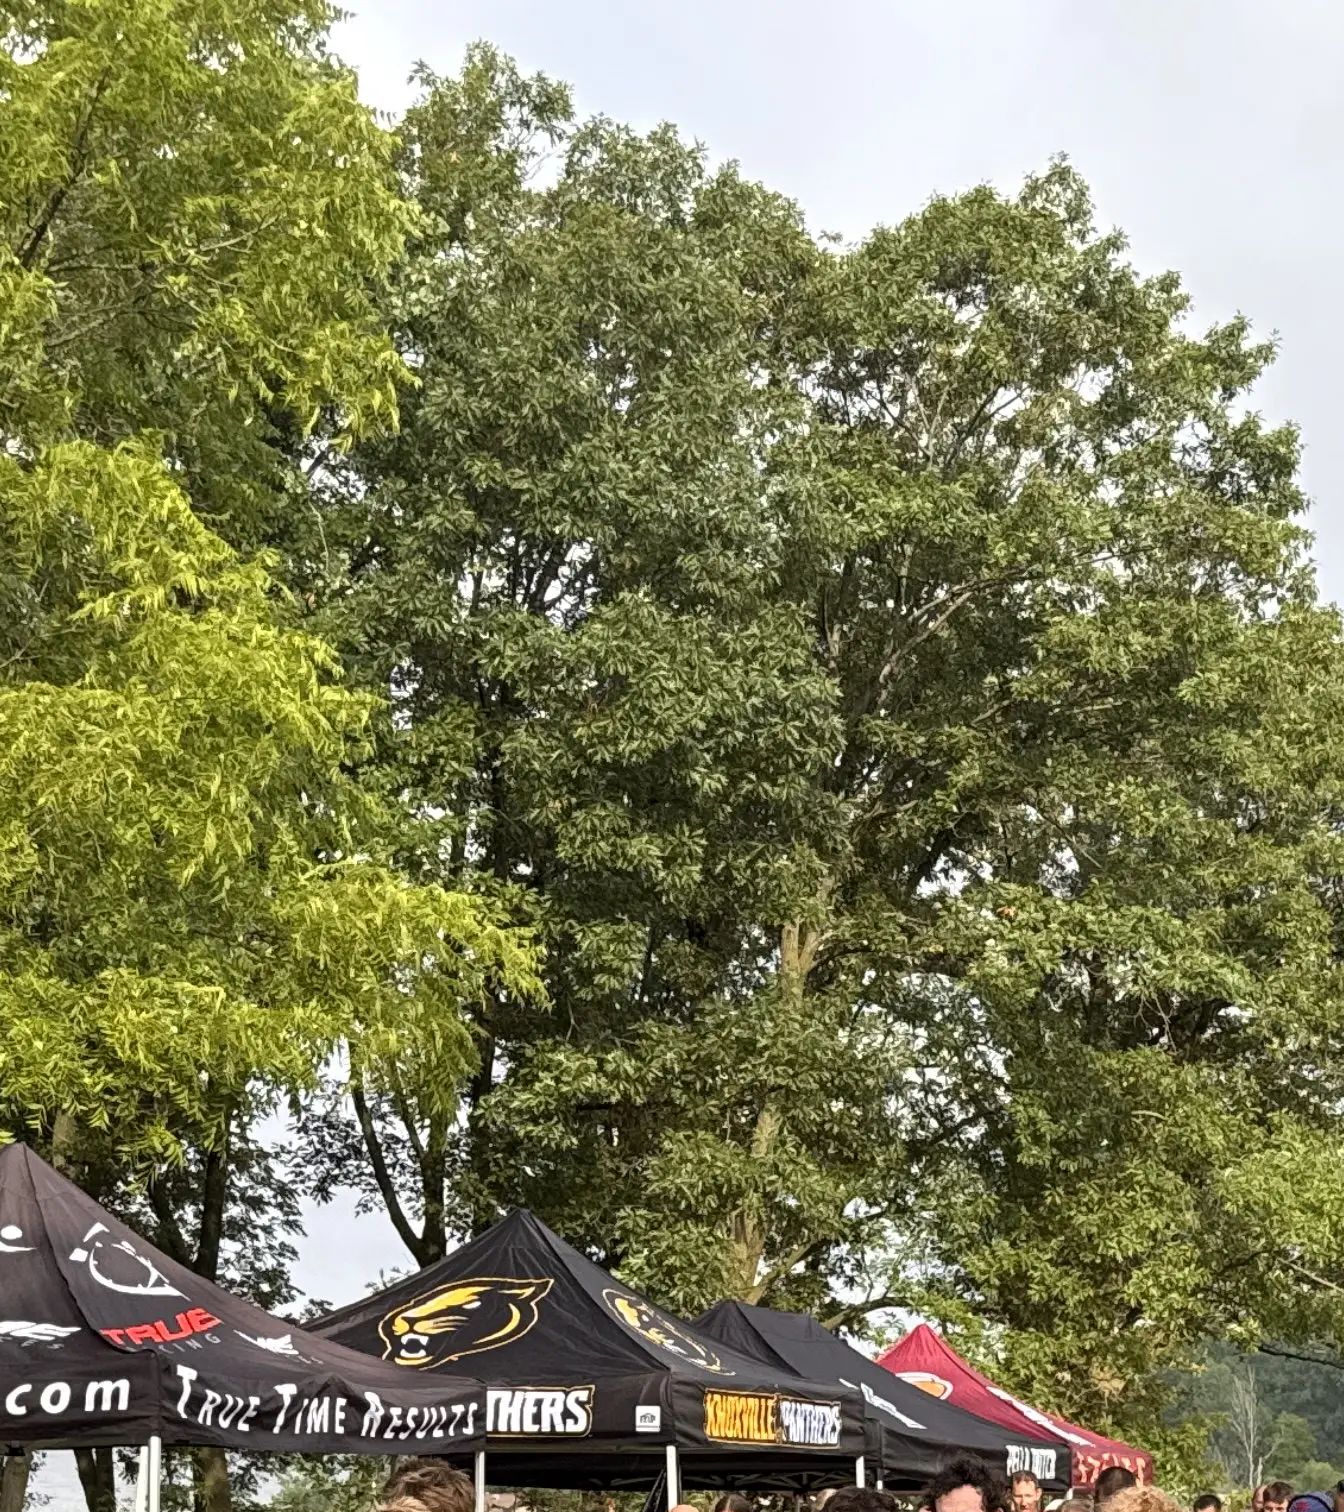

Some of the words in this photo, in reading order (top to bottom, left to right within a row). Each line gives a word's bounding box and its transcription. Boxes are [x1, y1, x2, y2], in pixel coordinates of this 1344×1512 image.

[99, 1307, 225, 1345] TRUE
[706, 1393, 776, 1441] KNOXVILLE
[779, 1399, 841, 1445] PANTHERS
